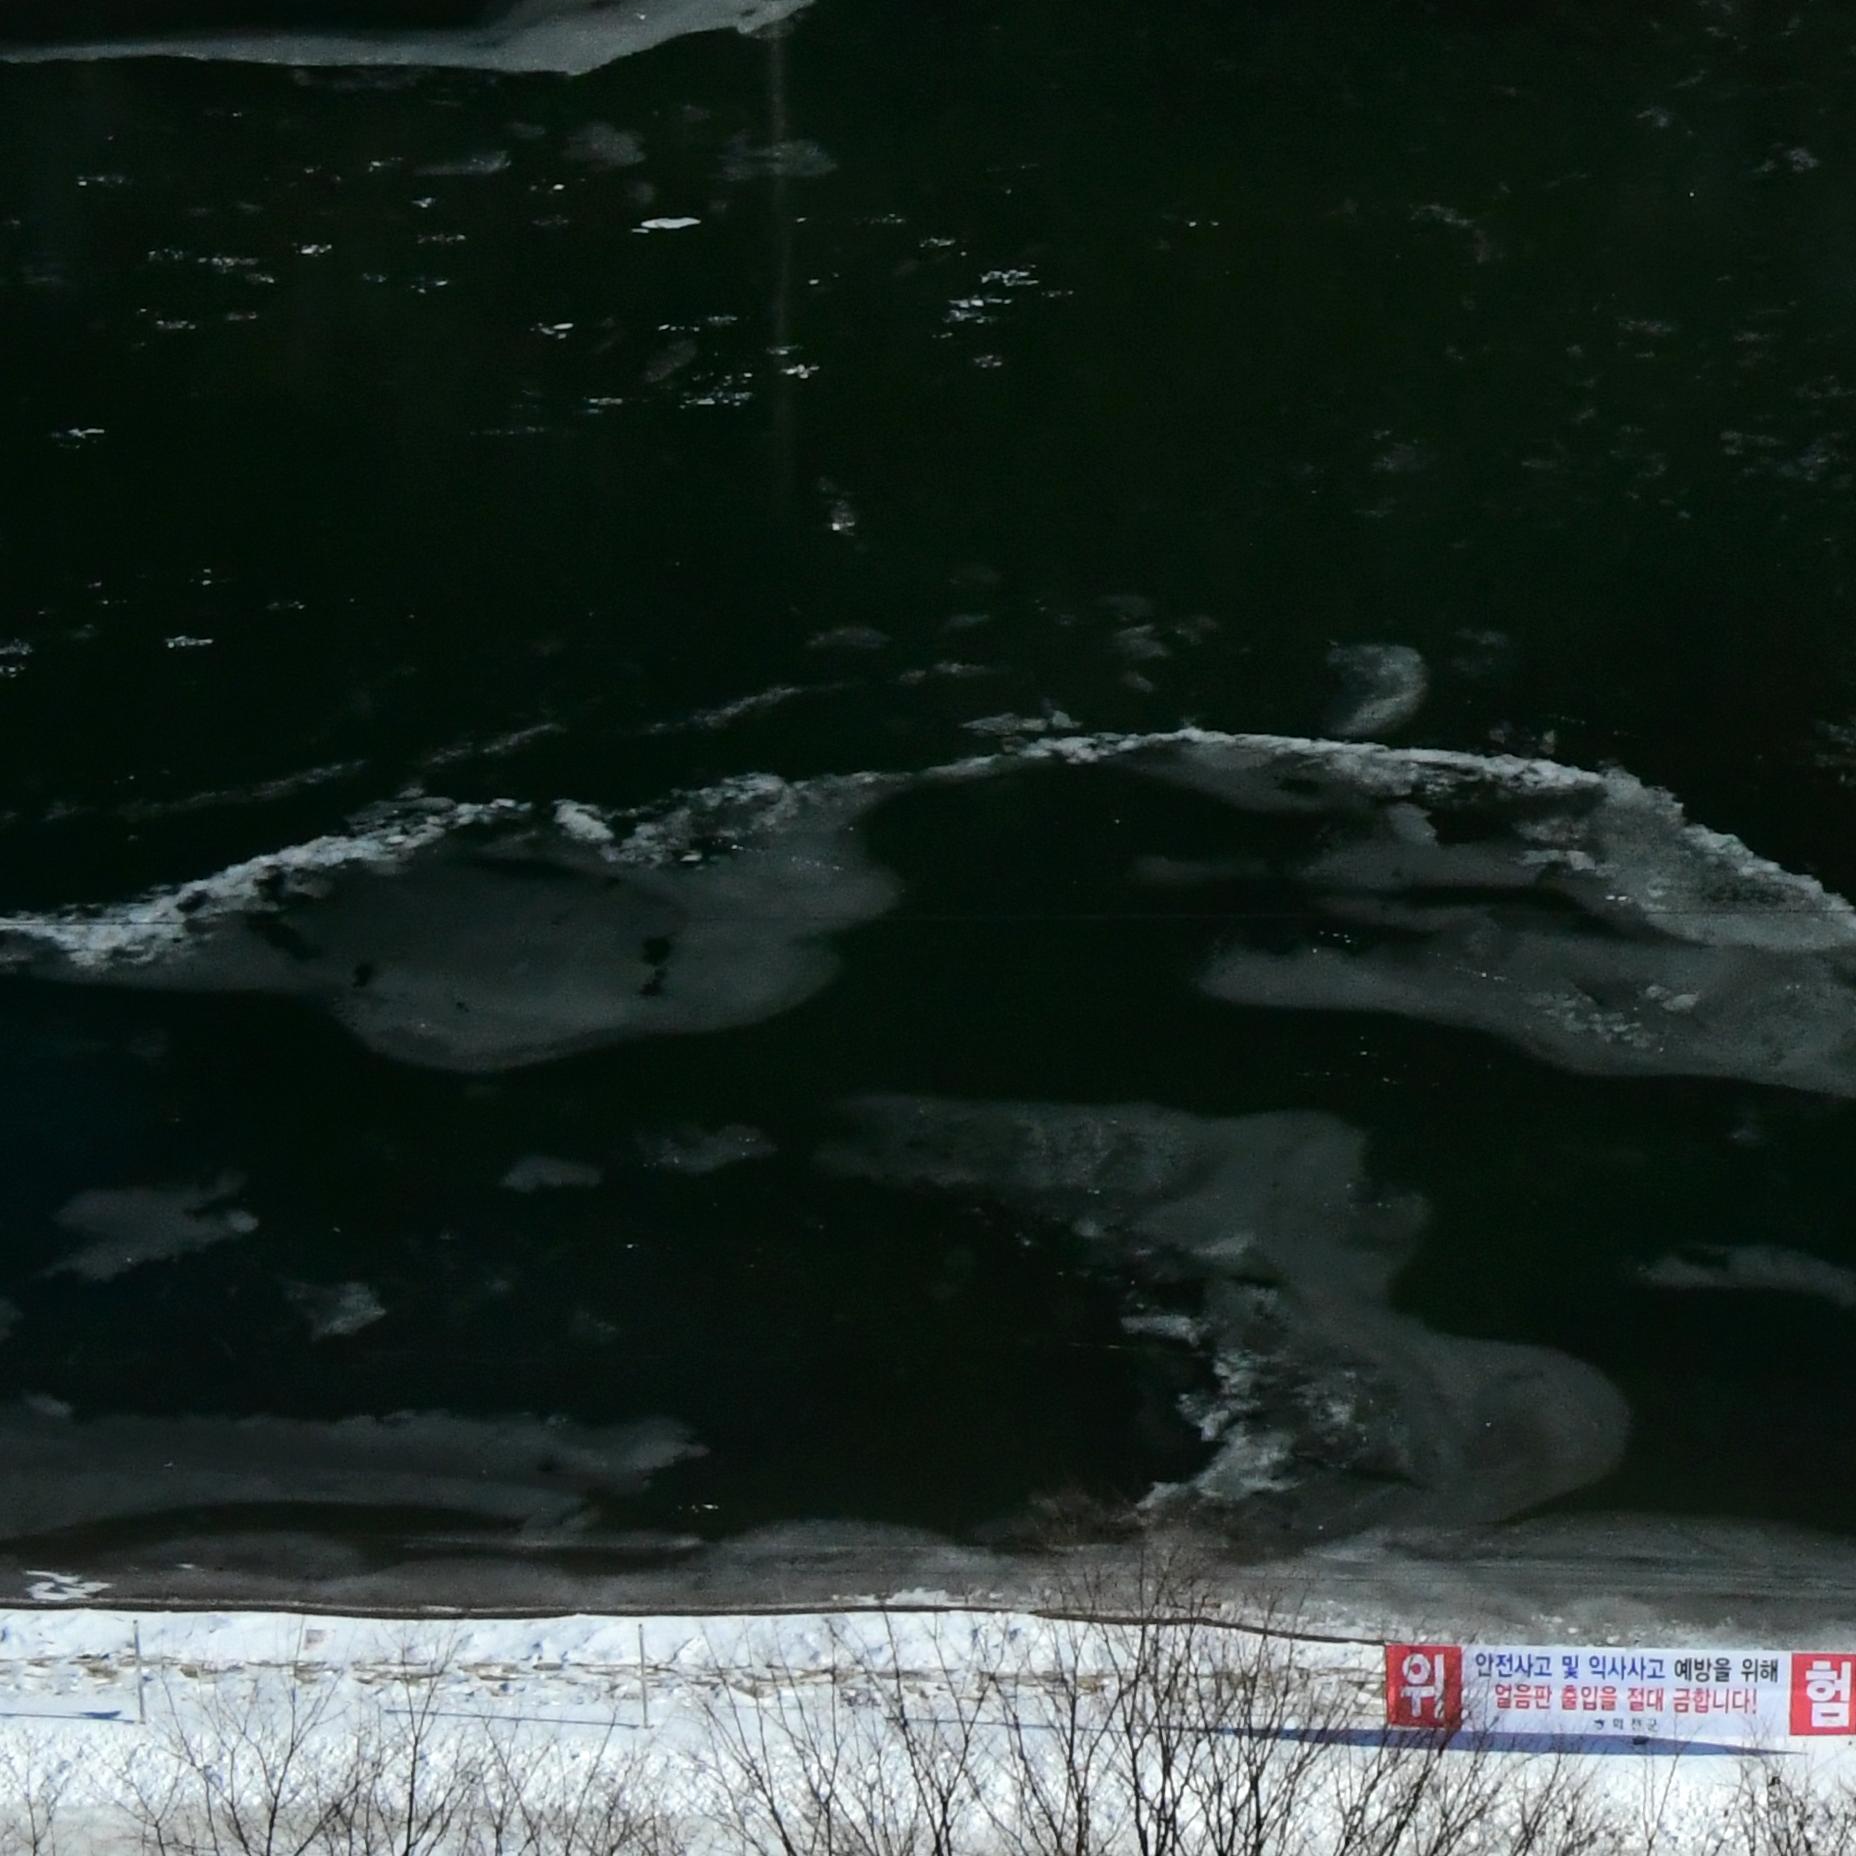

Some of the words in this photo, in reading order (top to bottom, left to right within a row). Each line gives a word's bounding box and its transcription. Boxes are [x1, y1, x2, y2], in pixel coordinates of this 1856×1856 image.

[1400, 1653, 1445, 1719] 위
[1475, 1652, 1552, 1678] 안전사고
[1562, 1654, 1579, 1680] 및
[1588, 1655, 1665, 1681] 익사사고
[1674, 1657, 1732, 1683] 예방을
[1741, 1658, 1779, 1683] 위해
[1494, 1683, 1552, 1709] 얼음판
[1561, 1684, 1618, 1711] 출입을
[1627, 1687, 1664, 1712] 절대
[1673, 1687, 1758, 1715] 금합니다!
[1805, 1660, 1852, 1728] 험
